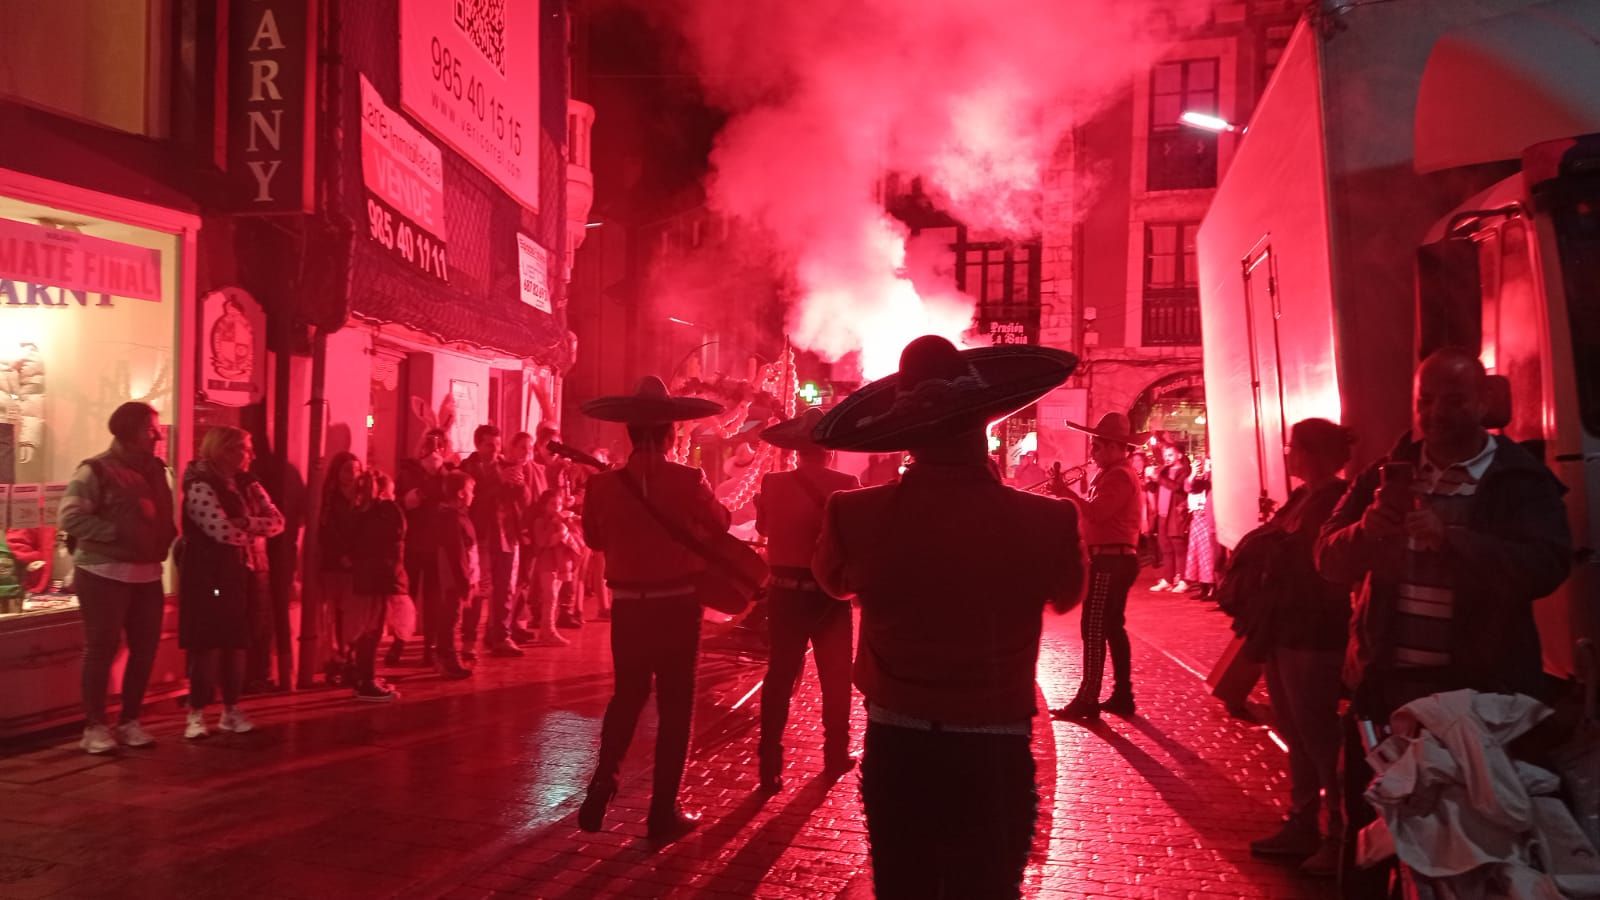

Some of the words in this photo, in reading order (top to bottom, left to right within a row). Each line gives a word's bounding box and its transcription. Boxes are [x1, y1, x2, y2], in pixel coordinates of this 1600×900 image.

[246, 0, 286, 201] ARNY
[431, 36, 463, 101] 985
[467, 75, 485, 122] 40
[490, 96, 505, 140] 15
[508, 116, 522, 157] 15
[373, 149, 434, 226] VENDE
[367, 198, 394, 251] 985
[397, 221, 414, 263] 40
[83, 249, 154, 296] FINAL
